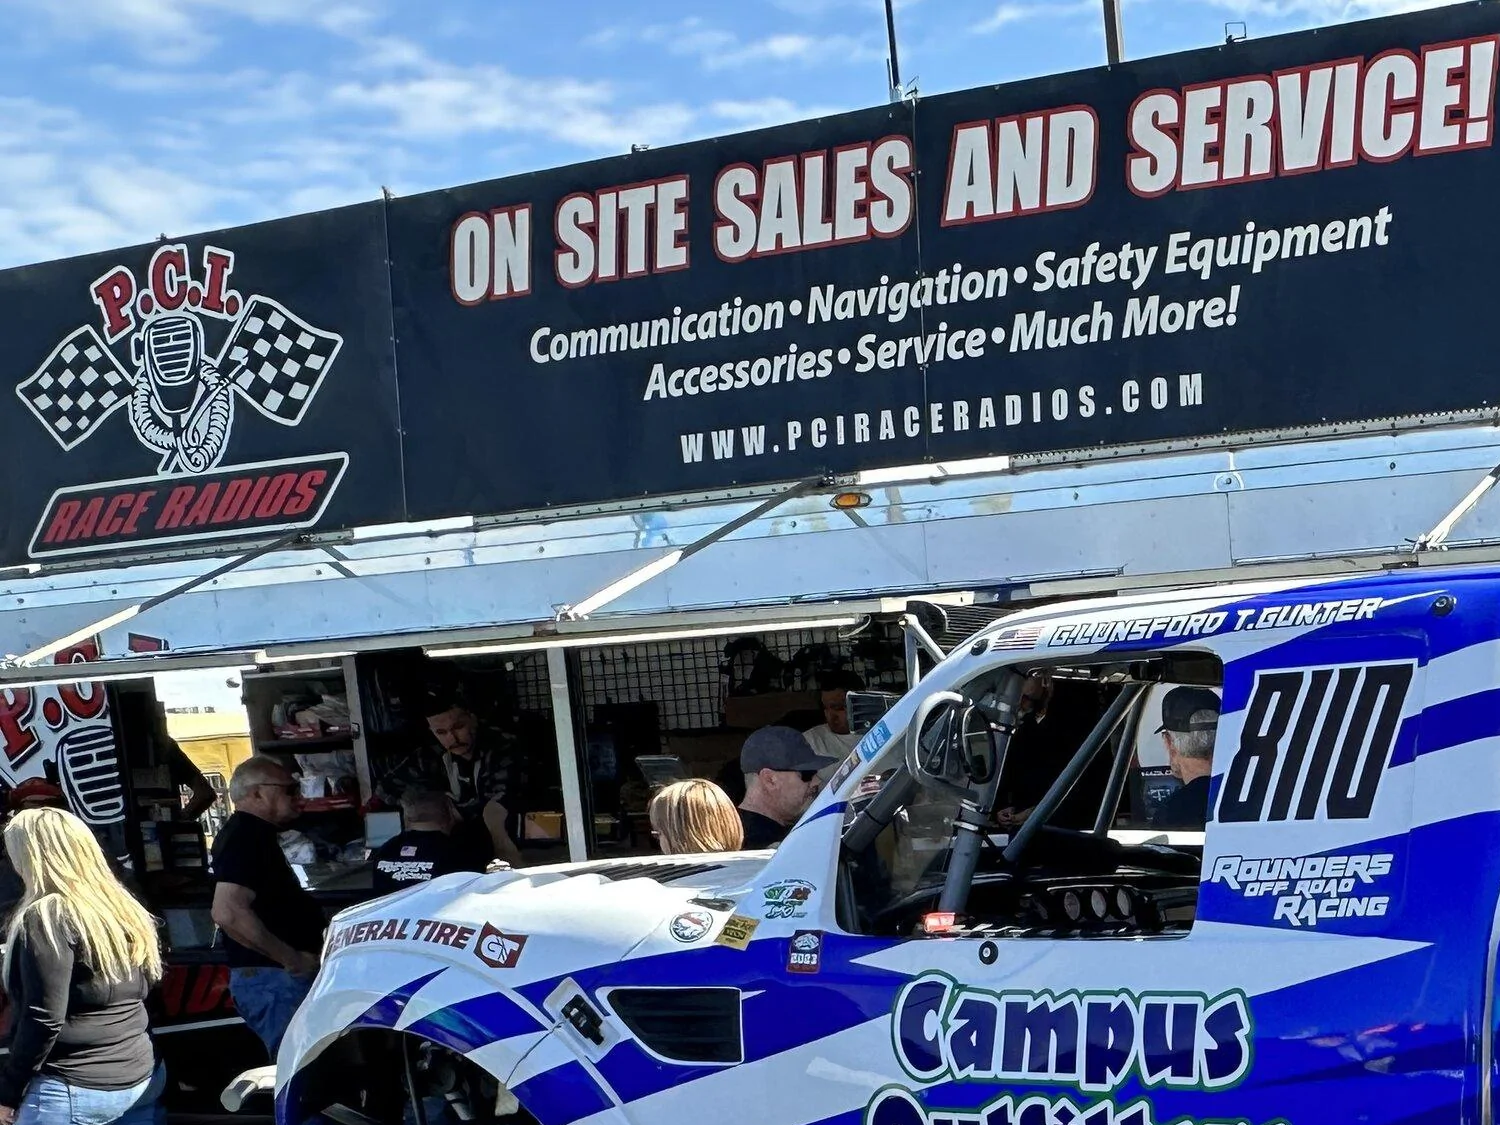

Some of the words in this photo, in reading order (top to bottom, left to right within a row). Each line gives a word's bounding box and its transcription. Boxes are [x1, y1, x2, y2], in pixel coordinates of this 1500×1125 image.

[450, 203, 532, 306] ON
[555, 175, 690, 289] SITE
[713, 135, 915, 263] SALES
[941, 104, 1098, 227] AND
[1127, 34, 1500, 198] SERVICE!
[91, 244, 241, 345] P.C.I.
[530, 297, 784, 363] Communication
[807, 263, 1008, 322] Navigation
[1033, 242, 1158, 290] Safety
[1166, 206, 1392, 279] Equipment
[644, 345, 832, 400] Accessories
[855, 323, 984, 373] Service
[1010, 301, 1113, 352] Much
[1122, 285, 1241, 339] More!
[681, 373, 1203, 464] WWW.PCIRACERADIOS.COM
[47, 490, 149, 545] RACE
[155, 468, 327, 530] RADIOS
[1232, 597, 1384, 632] T.GUNTER
[1211, 854, 1394, 890] ROUNDERS
[1244, 880, 1290, 897] OFF
[1294, 878, 1355, 899] ROAD
[1273, 895, 1390, 926] RACING
[412, 919, 476, 950] TIRE
[892, 973, 1252, 1090] Campus
